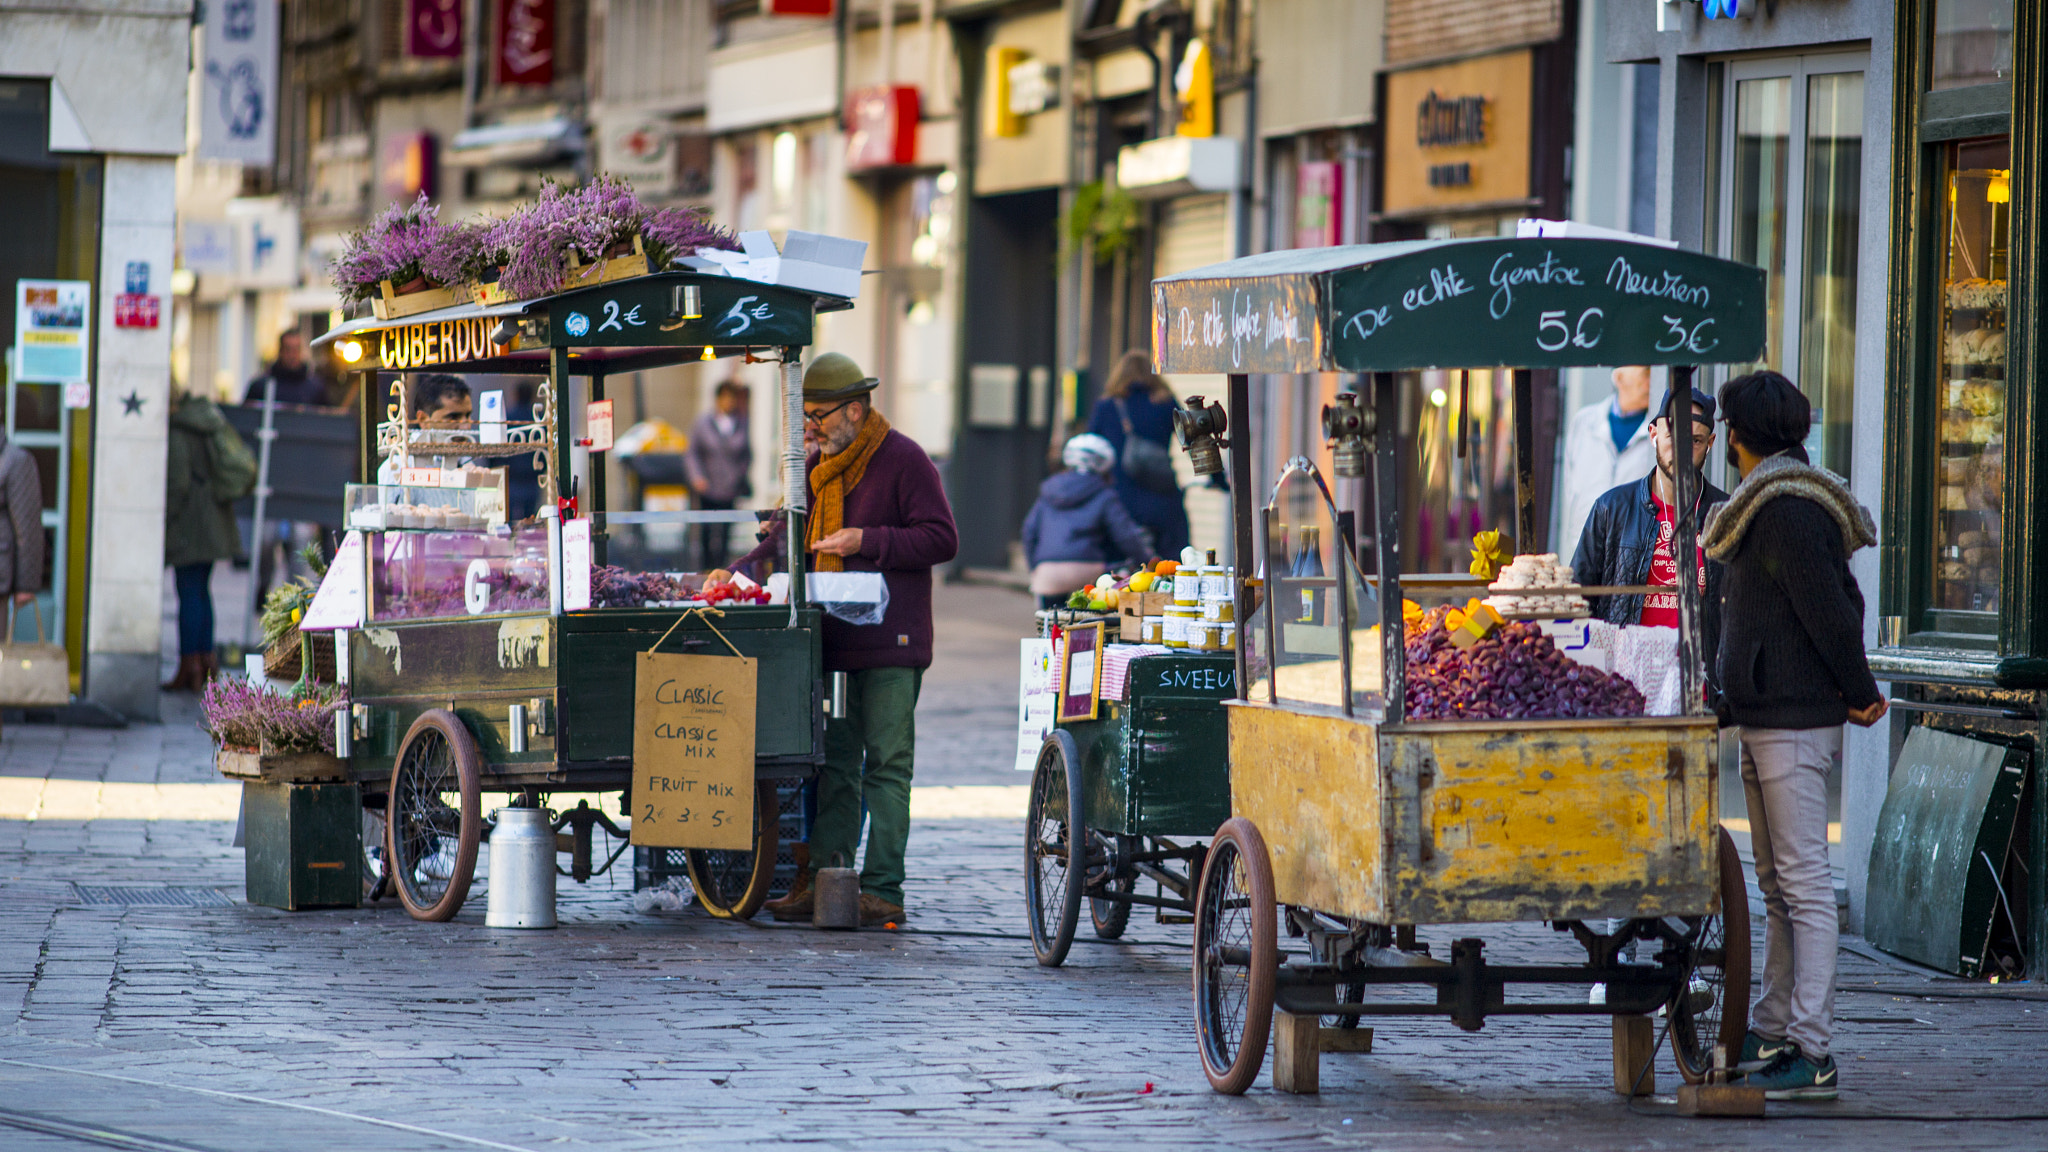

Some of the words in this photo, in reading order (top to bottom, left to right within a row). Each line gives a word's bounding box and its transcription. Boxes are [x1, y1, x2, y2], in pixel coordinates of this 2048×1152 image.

[598, 299, 646, 333] 2€
[729, 295, 774, 337] 5€
[1343, 304, 1393, 340] De
[1402, 263, 1475, 311] echte
[1489, 250, 1585, 320] Gentse
[1178, 306, 1196, 350] De
[1536, 307, 1604, 351] 5€
[1654, 314, 1719, 353] 3€
[1653, 559, 1677, 567] DIPLO
[464, 558, 491, 615] G
